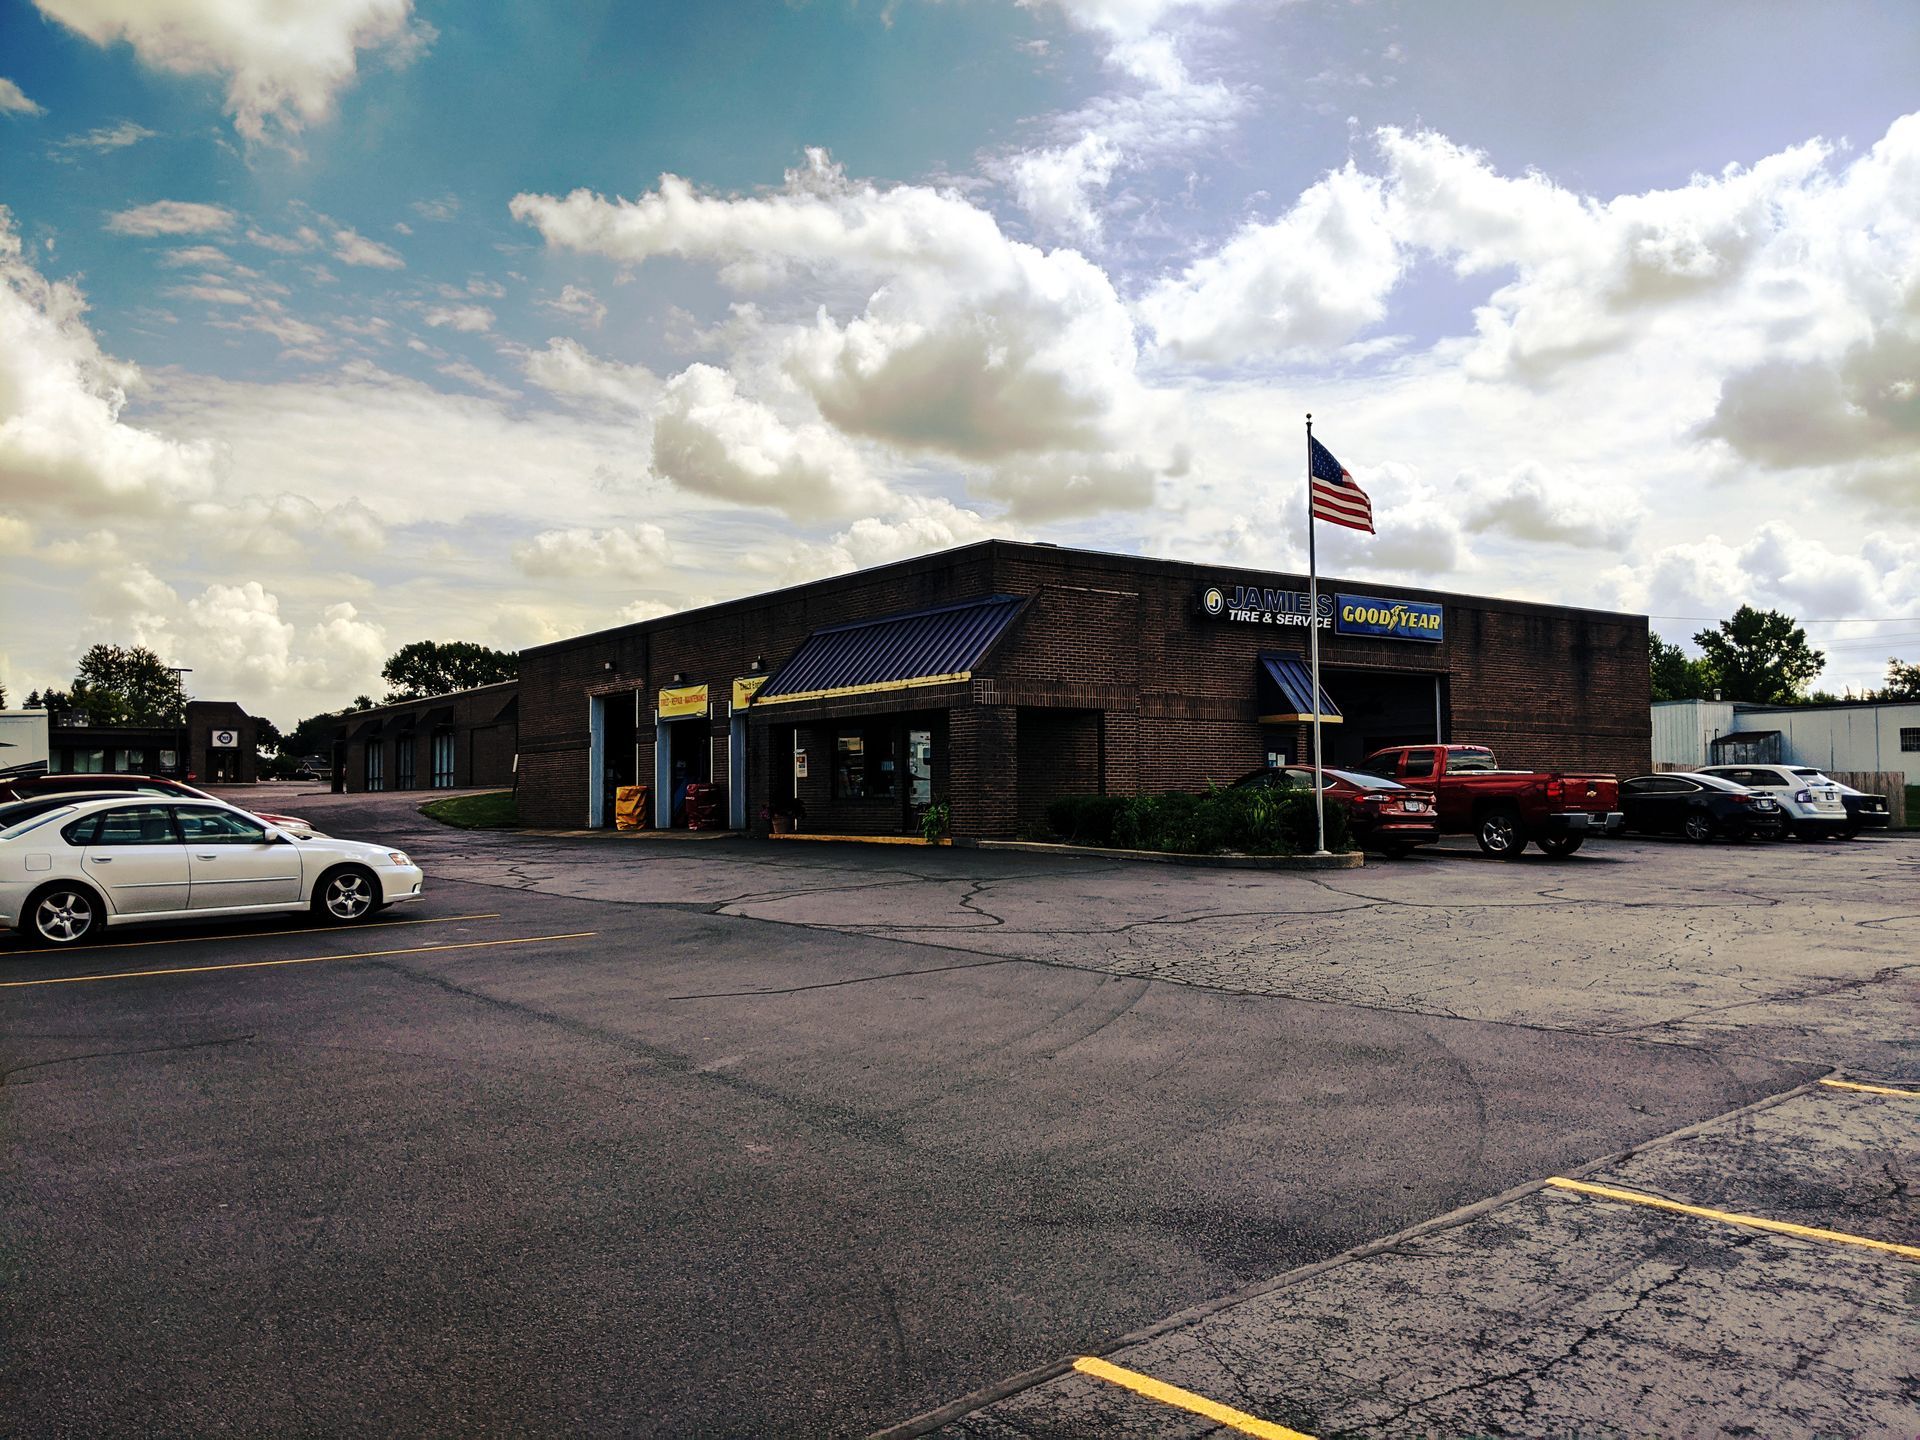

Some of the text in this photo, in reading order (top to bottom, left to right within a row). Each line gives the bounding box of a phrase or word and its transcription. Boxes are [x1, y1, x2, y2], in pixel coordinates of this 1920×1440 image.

[1226, 586, 1334, 617] JAMIES
[1228, 609, 1332, 629] TIRE & SERVCE
[1342, 605, 1441, 630] GOODYEAR
